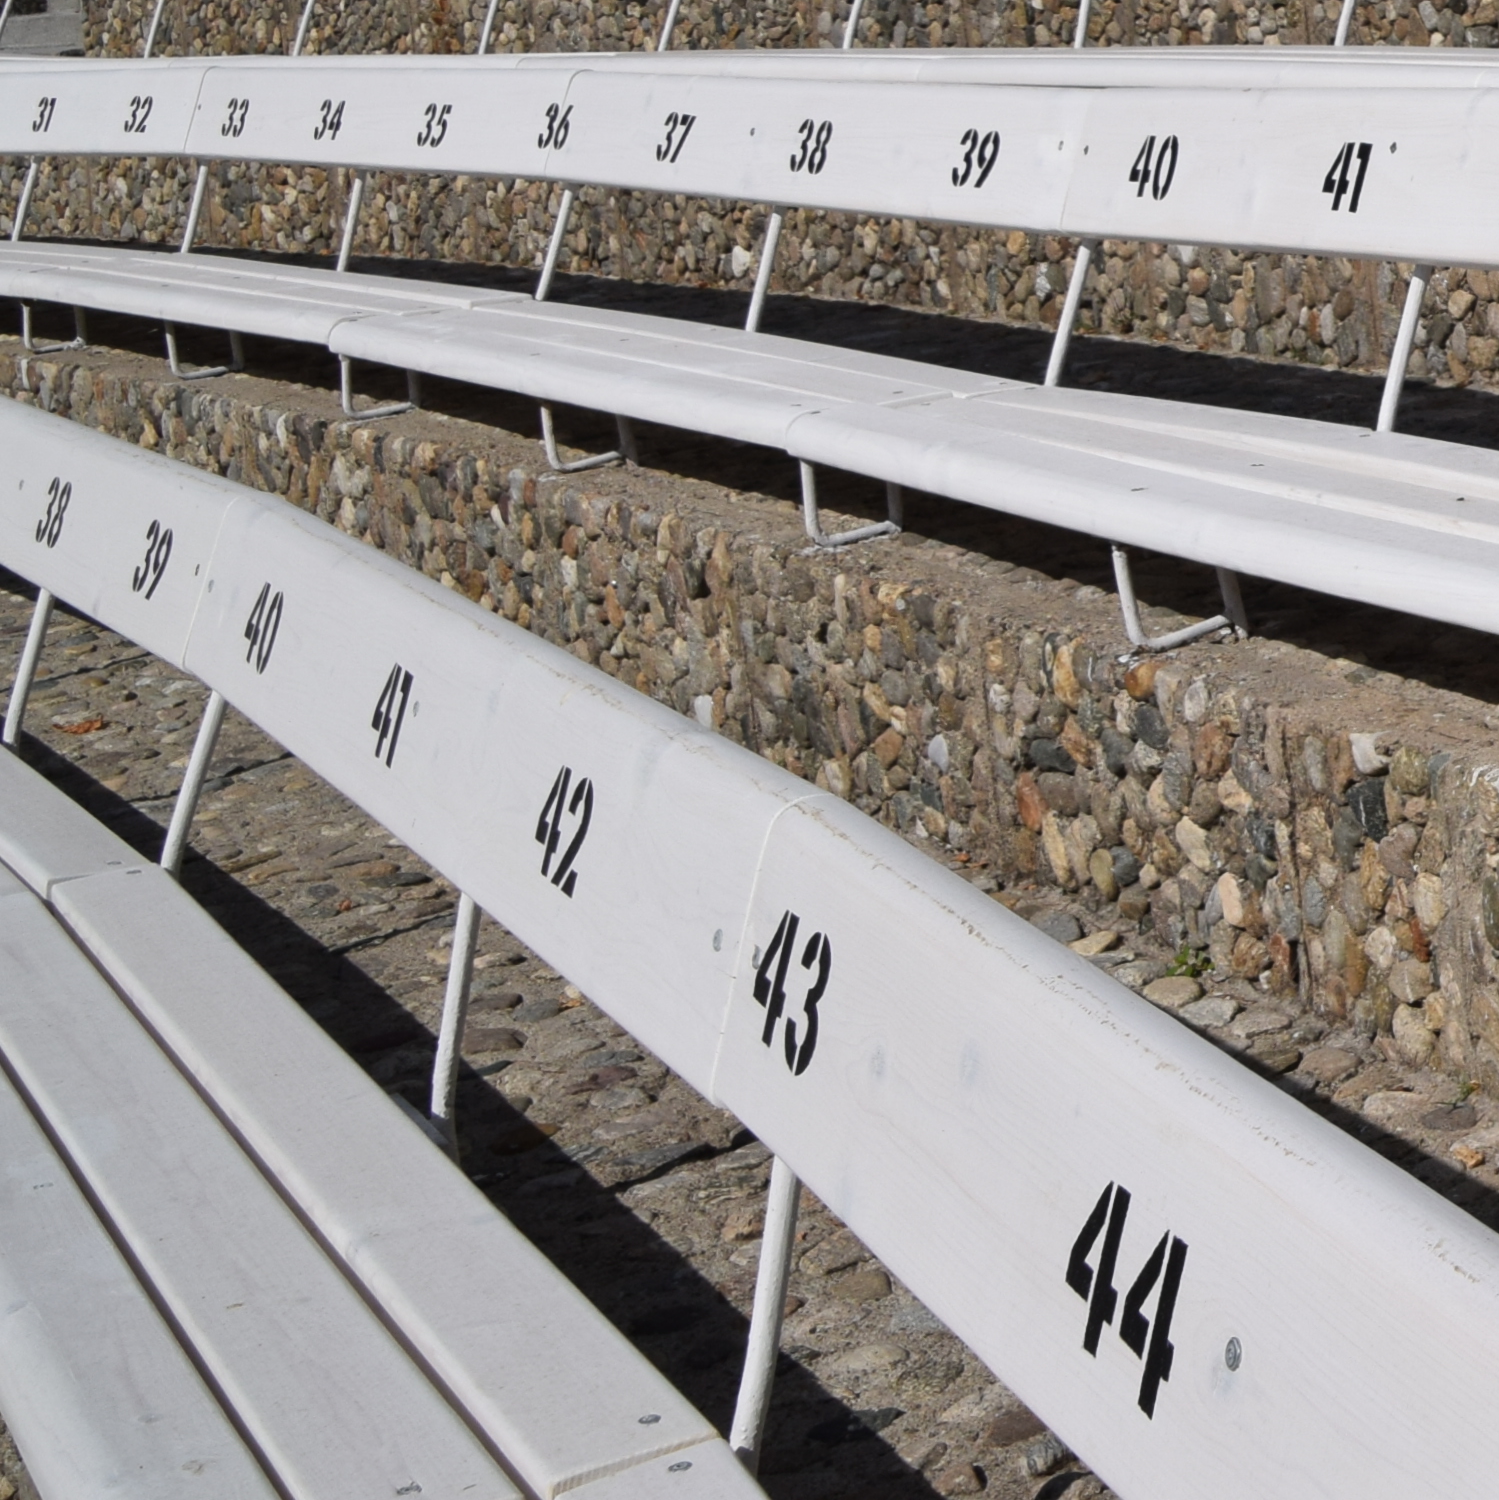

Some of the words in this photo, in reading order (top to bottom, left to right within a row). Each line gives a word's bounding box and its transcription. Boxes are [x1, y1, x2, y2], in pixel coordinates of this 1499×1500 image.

[33, 97, 56, 132] 31
[124, 96, 152, 132] 32
[222, 99, 249, 137] 33
[314, 100, 345, 140] 34
[417, 104, 452, 147] 35
[538, 104, 573, 149] 36
[657, 113, 696, 163] 37
[790, 119, 832, 174] 38
[952, 129, 1000, 188] 39
[1129, 136, 1178, 200] 40
[1322, 143, 1372, 213] 41
[36, 478, 71, 548] 38
[133, 520, 172, 600] 39
[245, 583, 283, 674] 40
[372, 665, 413, 768] 41
[535, 767, 593, 898] 42
[753, 911, 831, 1076] 43
[1066, 1181, 1188, 1420] 44
